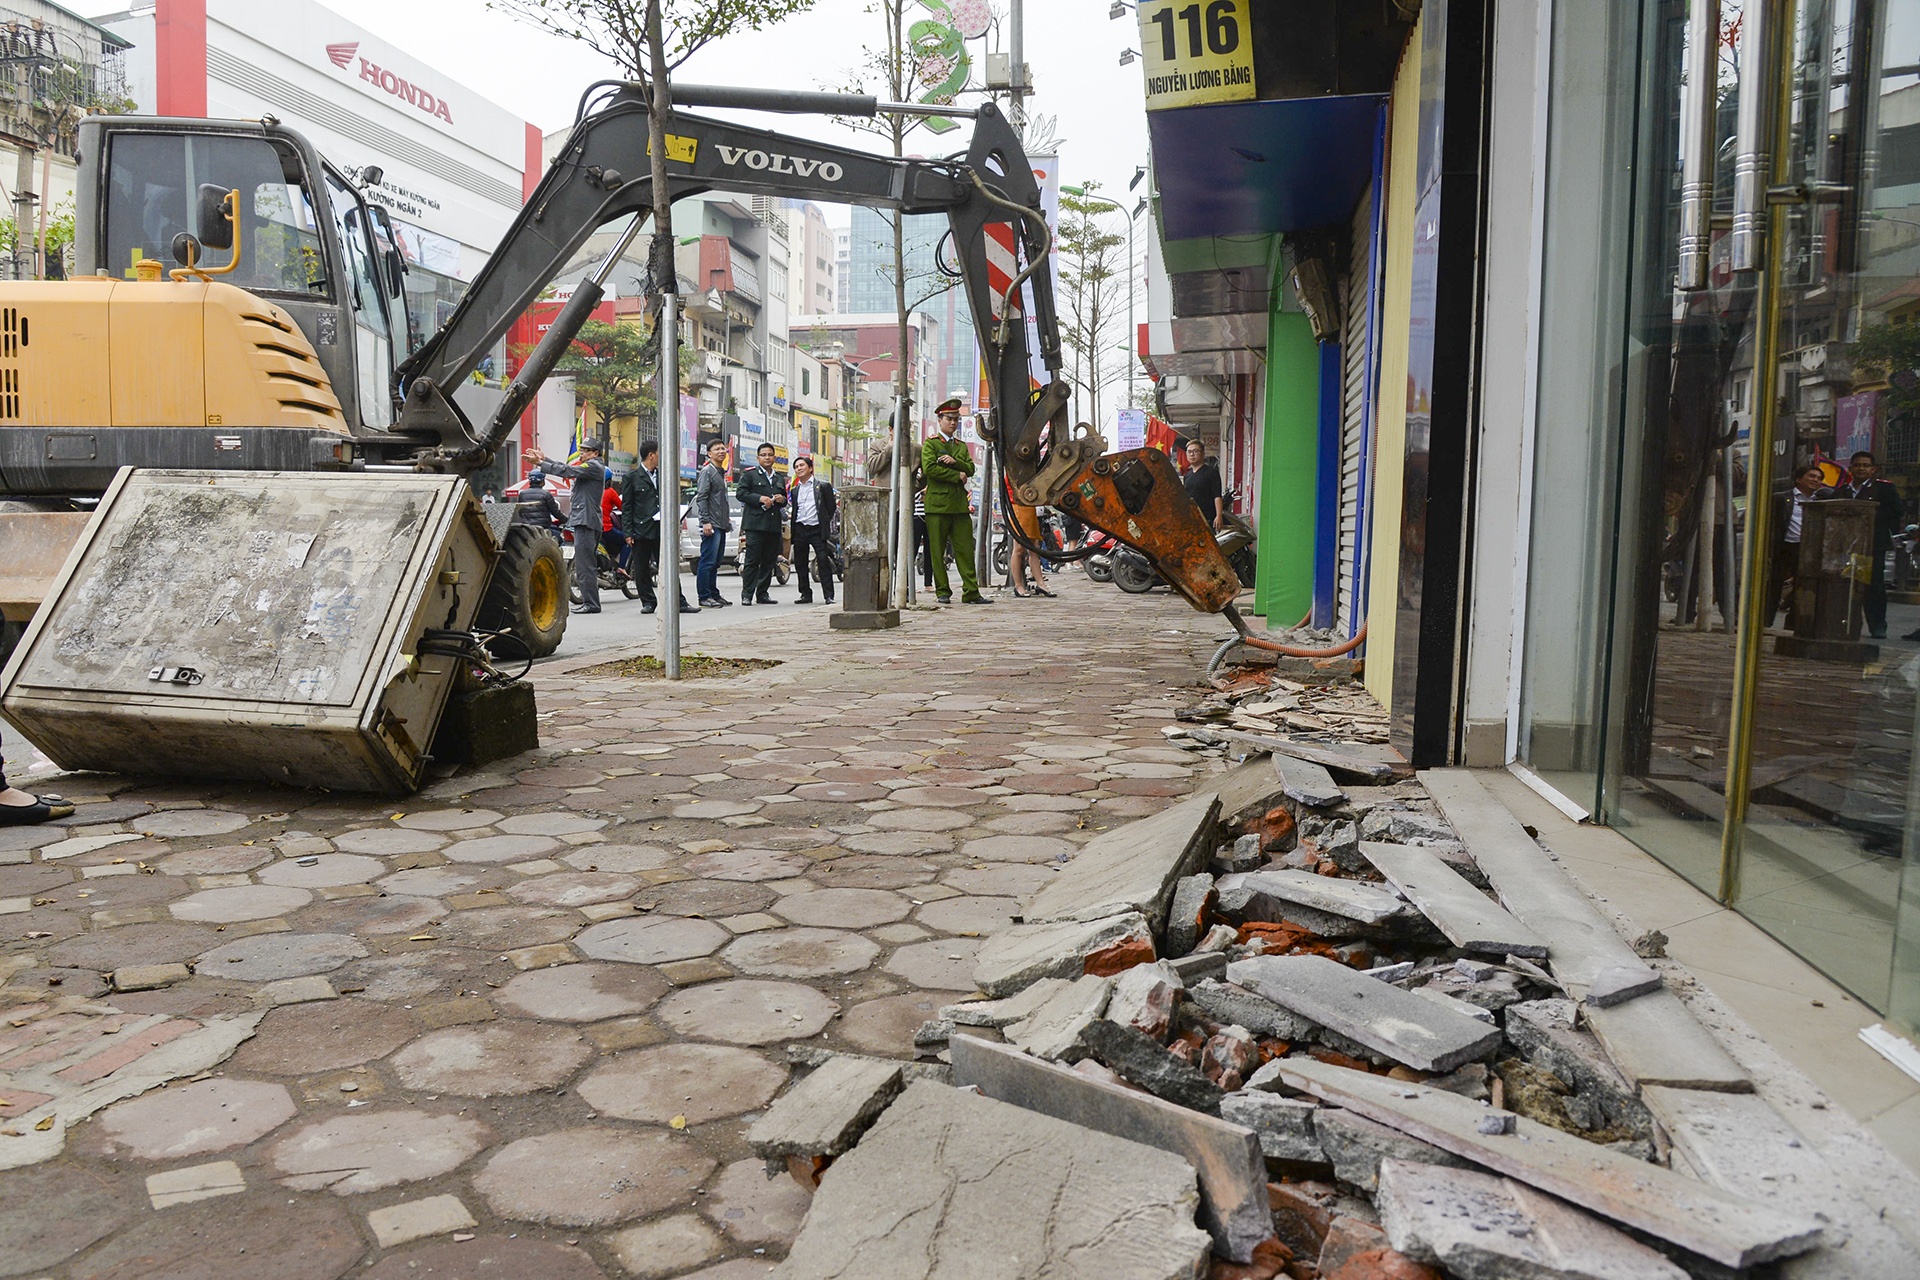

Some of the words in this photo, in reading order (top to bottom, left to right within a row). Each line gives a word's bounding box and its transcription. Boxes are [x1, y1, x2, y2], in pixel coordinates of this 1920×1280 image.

[1152, 0, 1239, 61] 116
[359, 57, 454, 125] HONDA
[1148, 68, 1187, 95] NGUYỄN
[714, 144, 843, 182] VOLVO
[391, 184, 397, 194] XE
[418, 209, 422, 218] 2
